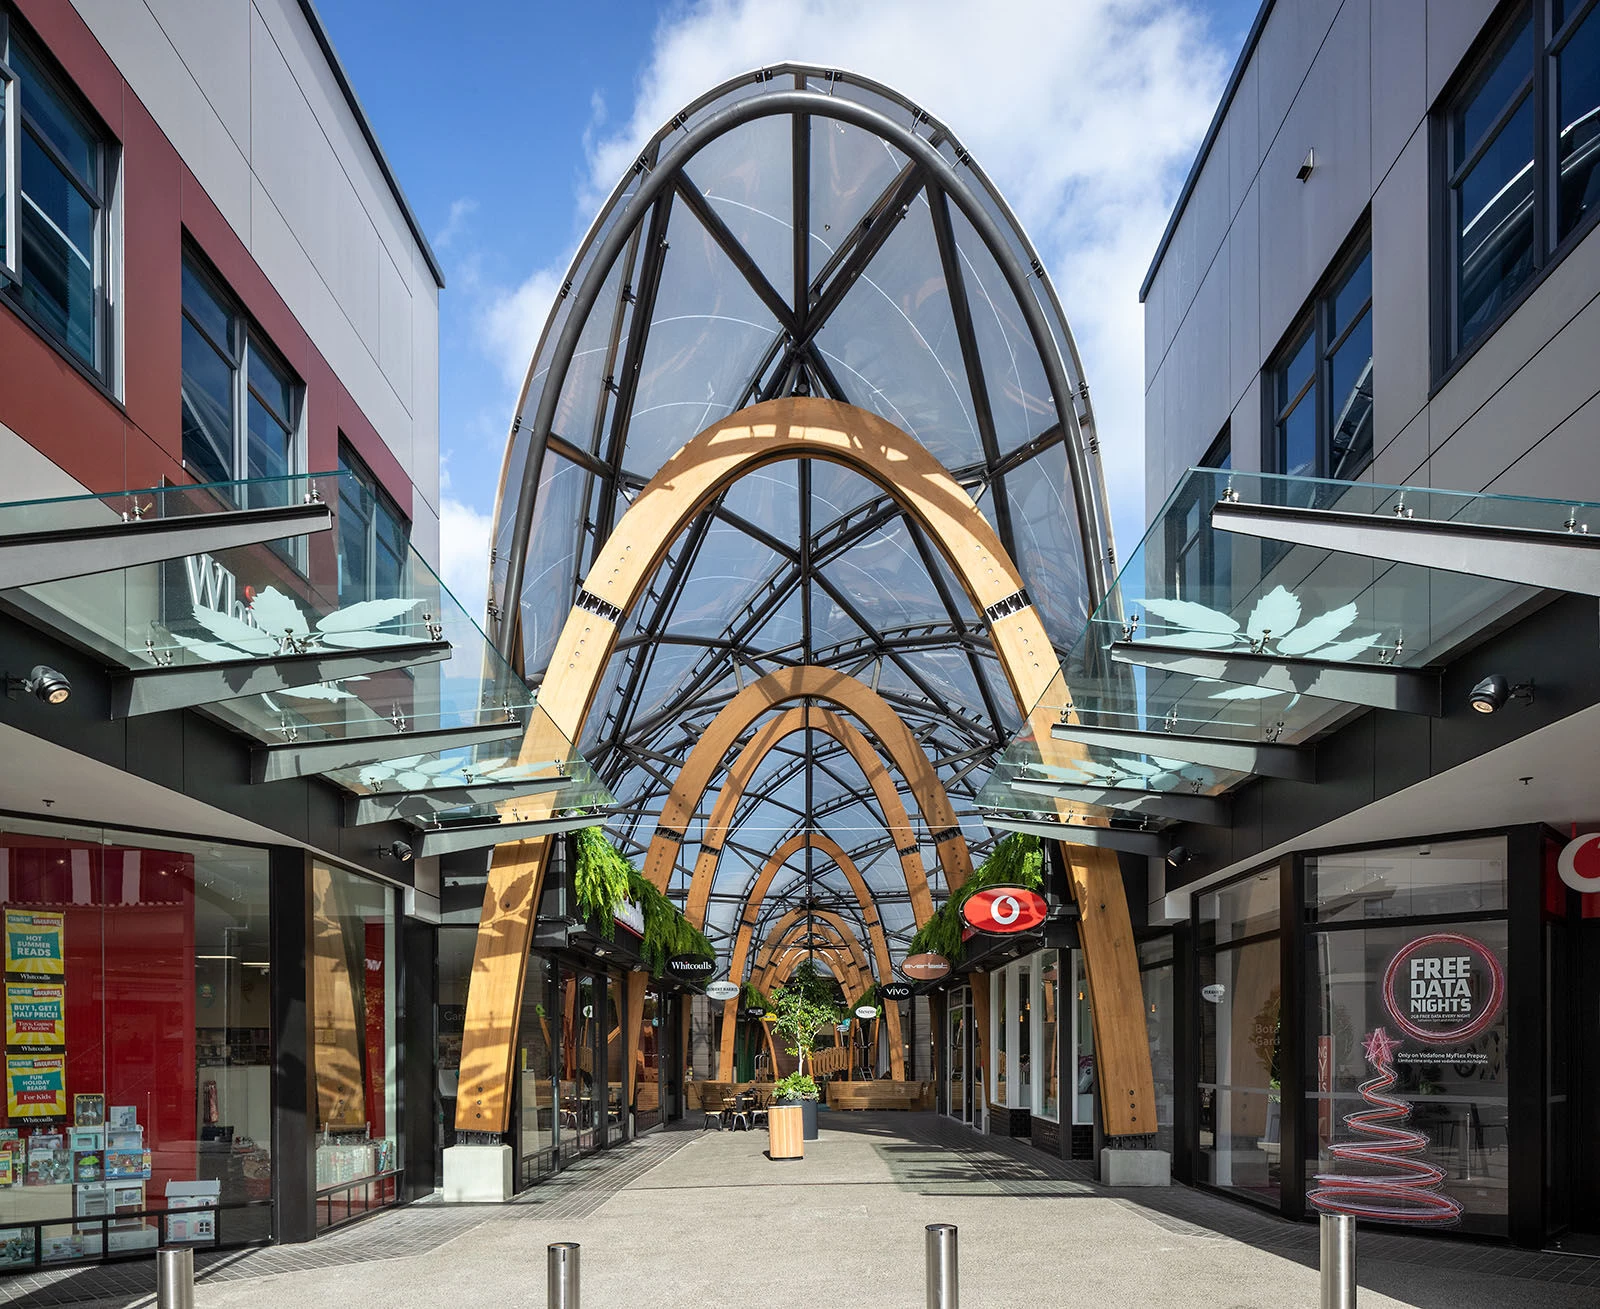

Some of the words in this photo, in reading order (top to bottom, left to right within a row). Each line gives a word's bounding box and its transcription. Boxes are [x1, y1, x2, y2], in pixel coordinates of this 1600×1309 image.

[17, 948, 51, 956] READS
[672, 961, 712, 970] Whitcoulls
[1411, 956, 1470, 979] FREE
[1411, 979, 1472, 998] DATA
[1411, 999, 1471, 1012] NIGHTS
[1256, 1024, 1280, 1034] Bota
